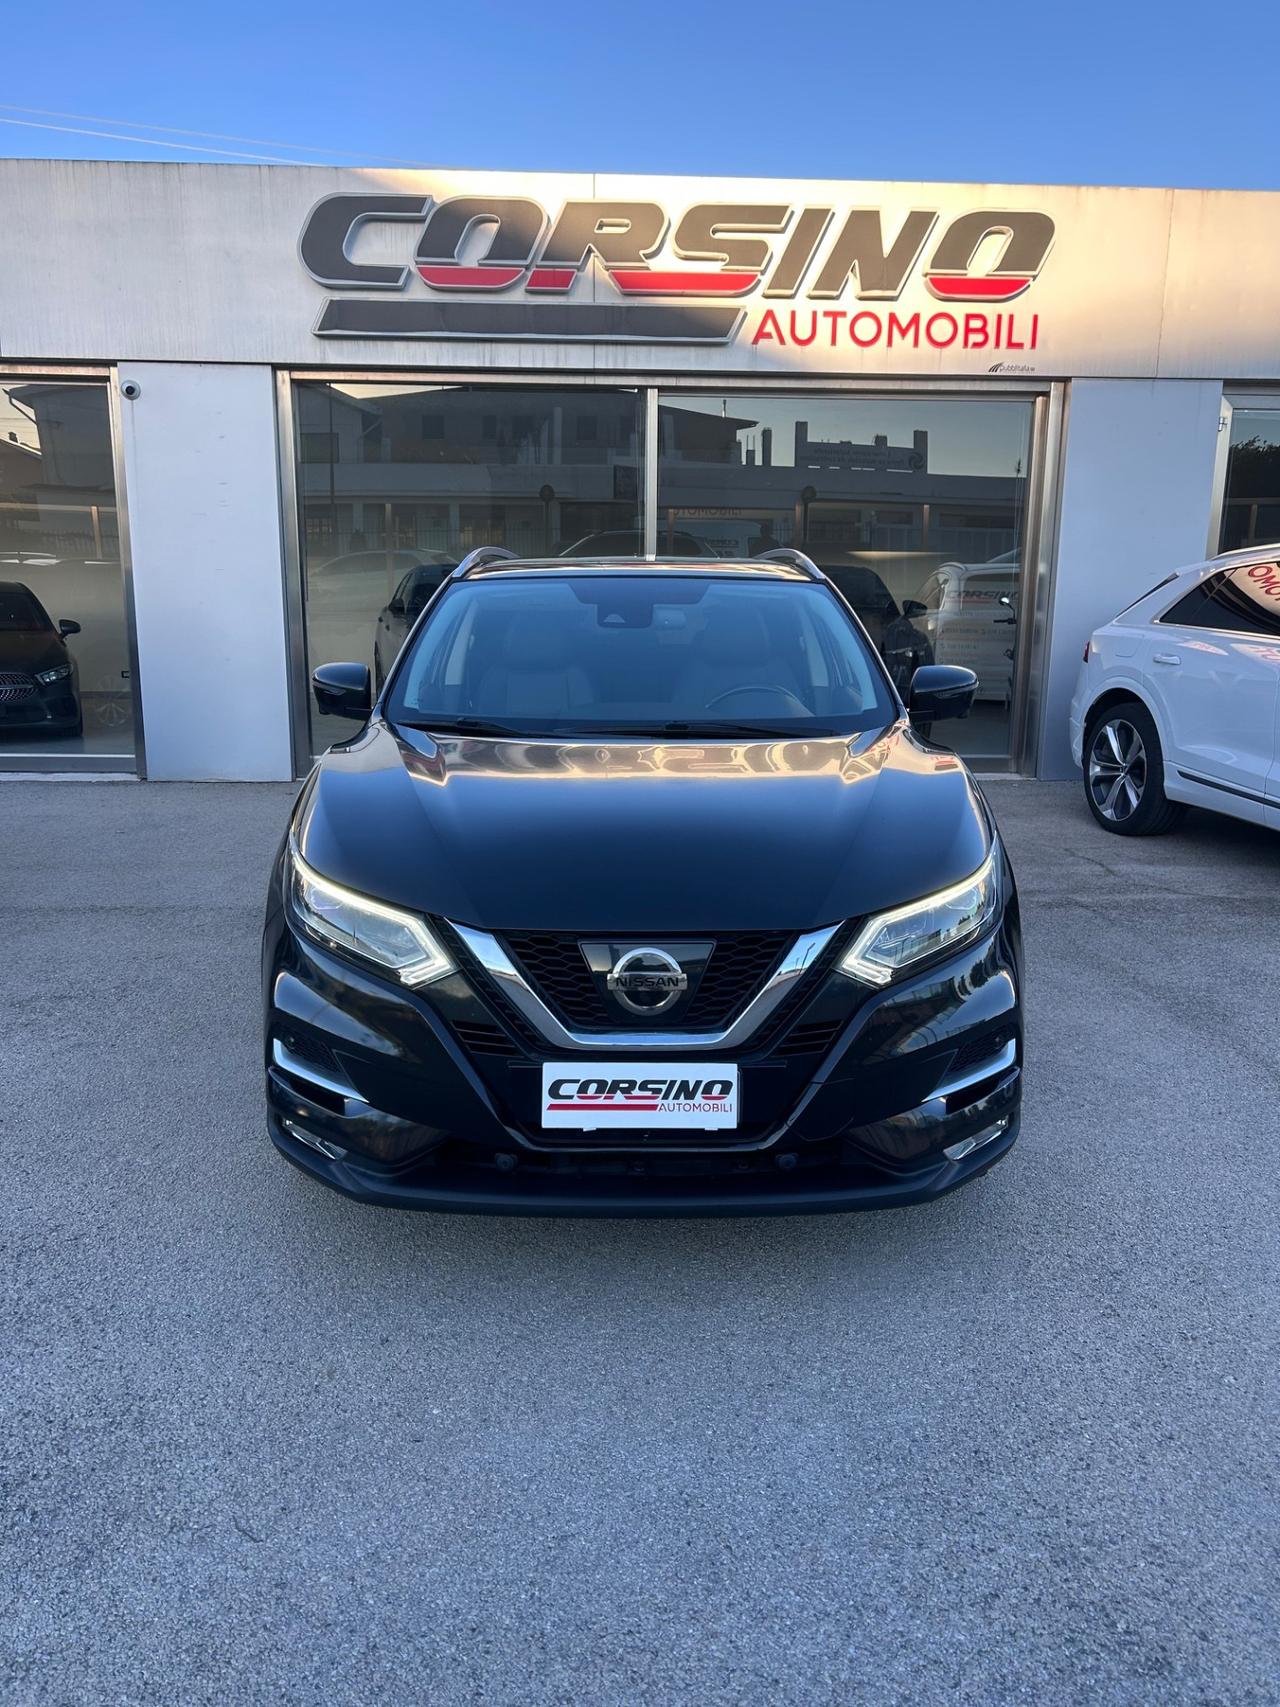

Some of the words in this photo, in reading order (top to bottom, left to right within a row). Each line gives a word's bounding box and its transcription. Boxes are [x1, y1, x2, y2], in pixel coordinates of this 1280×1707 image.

[299, 191, 1056, 303] CORSINO
[751, 308, 1039, 350] AUTOMOBILI
[615, 976, 679, 988] NISSAN
[547, 1078, 734, 1101] CORSINO
[657, 1102, 733, 1113] AUTOMOBILI
